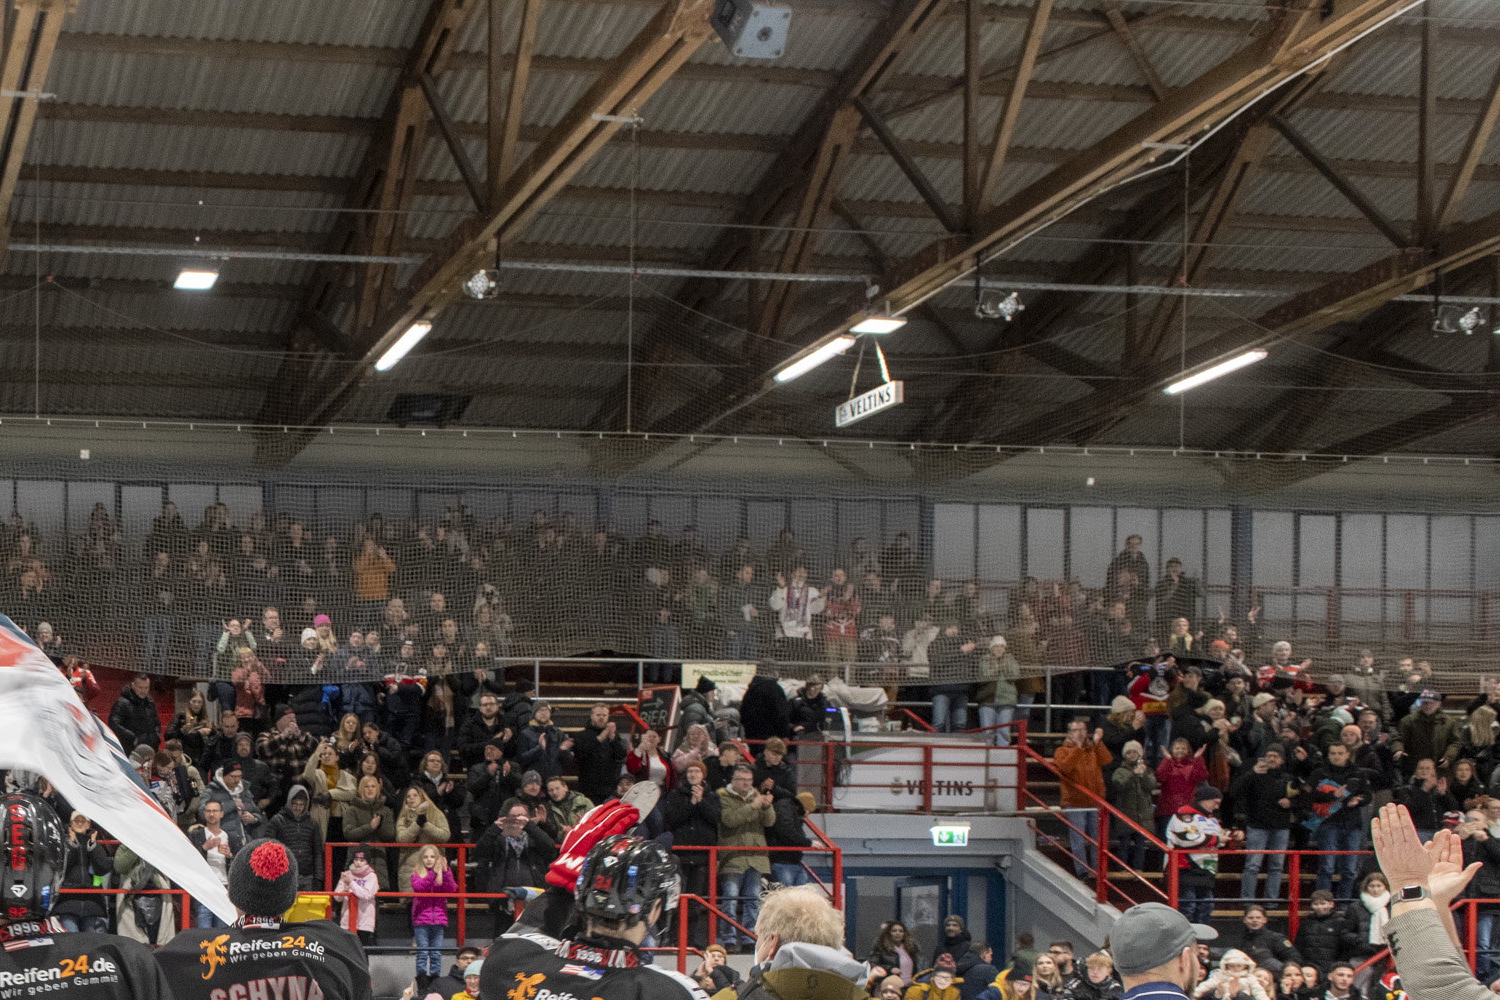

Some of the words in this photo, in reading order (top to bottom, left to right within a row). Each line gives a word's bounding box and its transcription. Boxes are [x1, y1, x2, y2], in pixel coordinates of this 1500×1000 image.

[849, 387, 891, 418] VELTINS
[7, 923, 40, 937] 1996
[229, 936, 325, 956] Reifen24.de
[230, 954, 248, 964] Wir
[253, 950, 287, 961] geben
[292, 949, 325, 962] Gummi!
[1, 987, 22, 1000] Wir
[27, 981, 69, 996] geben
